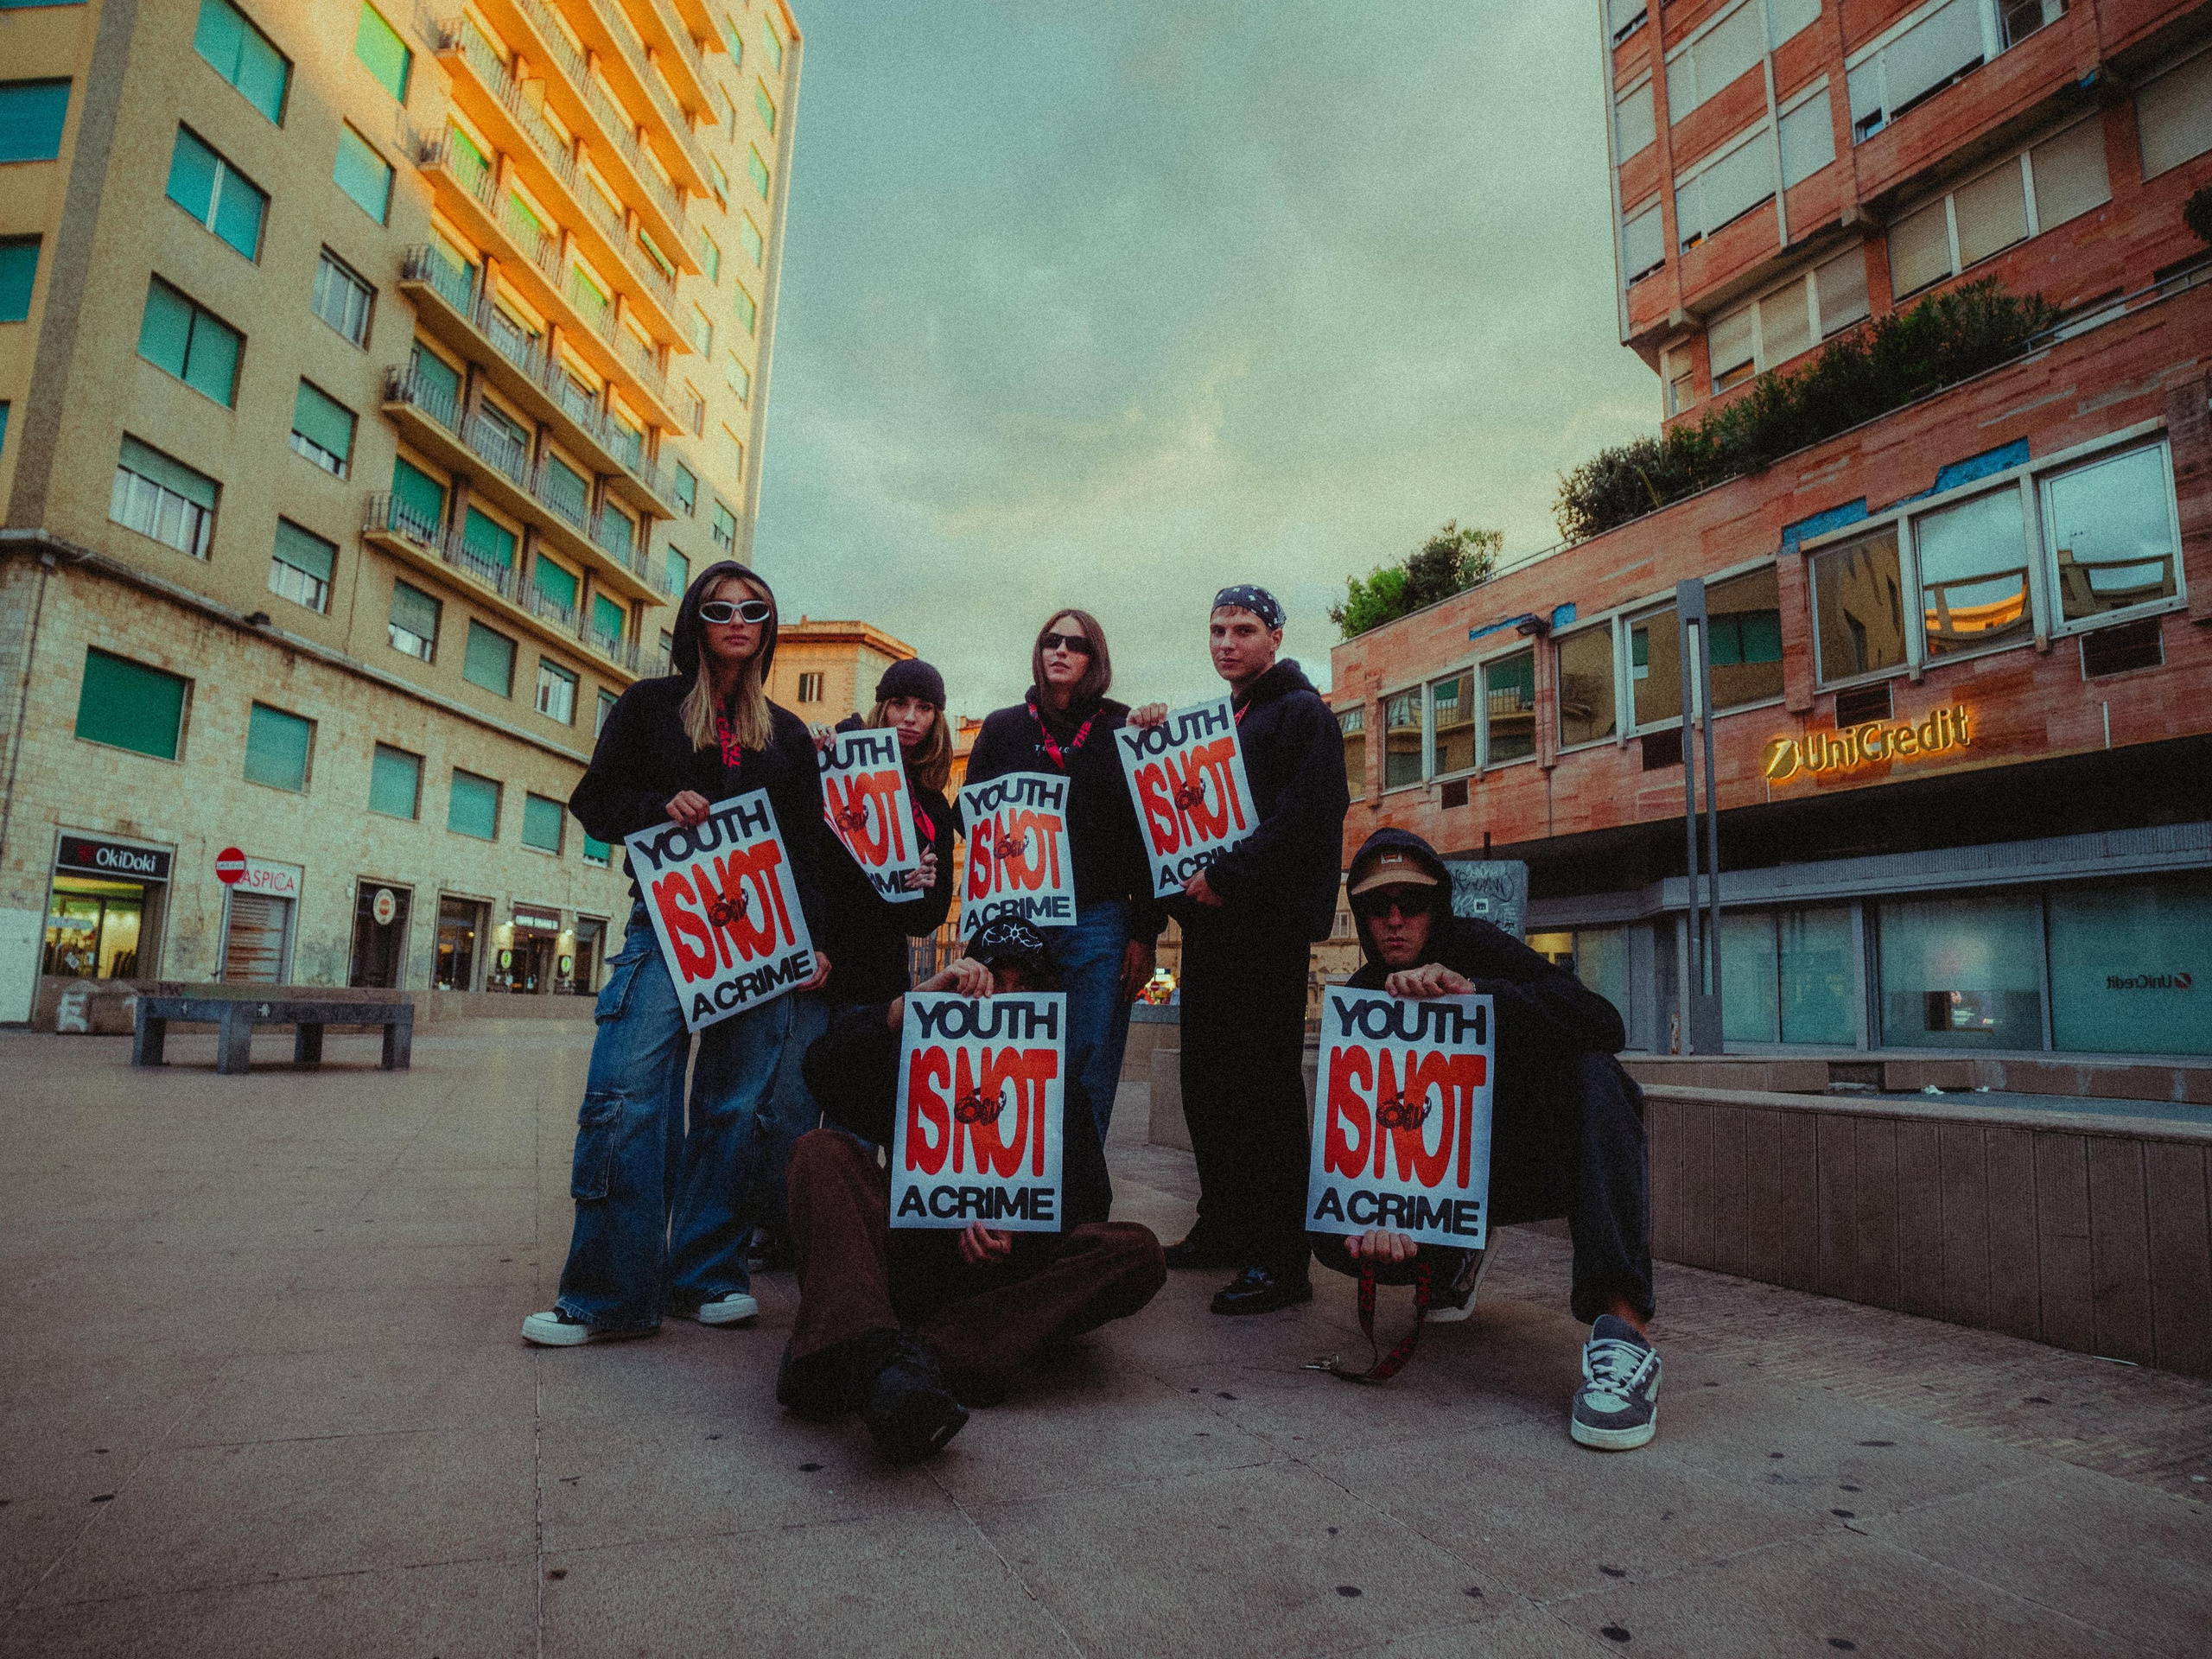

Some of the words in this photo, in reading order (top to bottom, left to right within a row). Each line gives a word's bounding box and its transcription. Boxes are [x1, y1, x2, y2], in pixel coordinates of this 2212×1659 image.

[1122, 703, 1230, 761] YOUTH
[1802, 705, 1970, 771] UniCredit
[817, 735, 895, 772] OUTH
[964, 778, 1064, 816] YOUTH
[633, 798, 771, 870] YOUTH
[96, 847, 156, 873] OkiDoki
[236, 869, 295, 892] ASPICA
[912, 1000, 1058, 1039] YOUTH
[1332, 995, 1487, 1046] YOUTH
